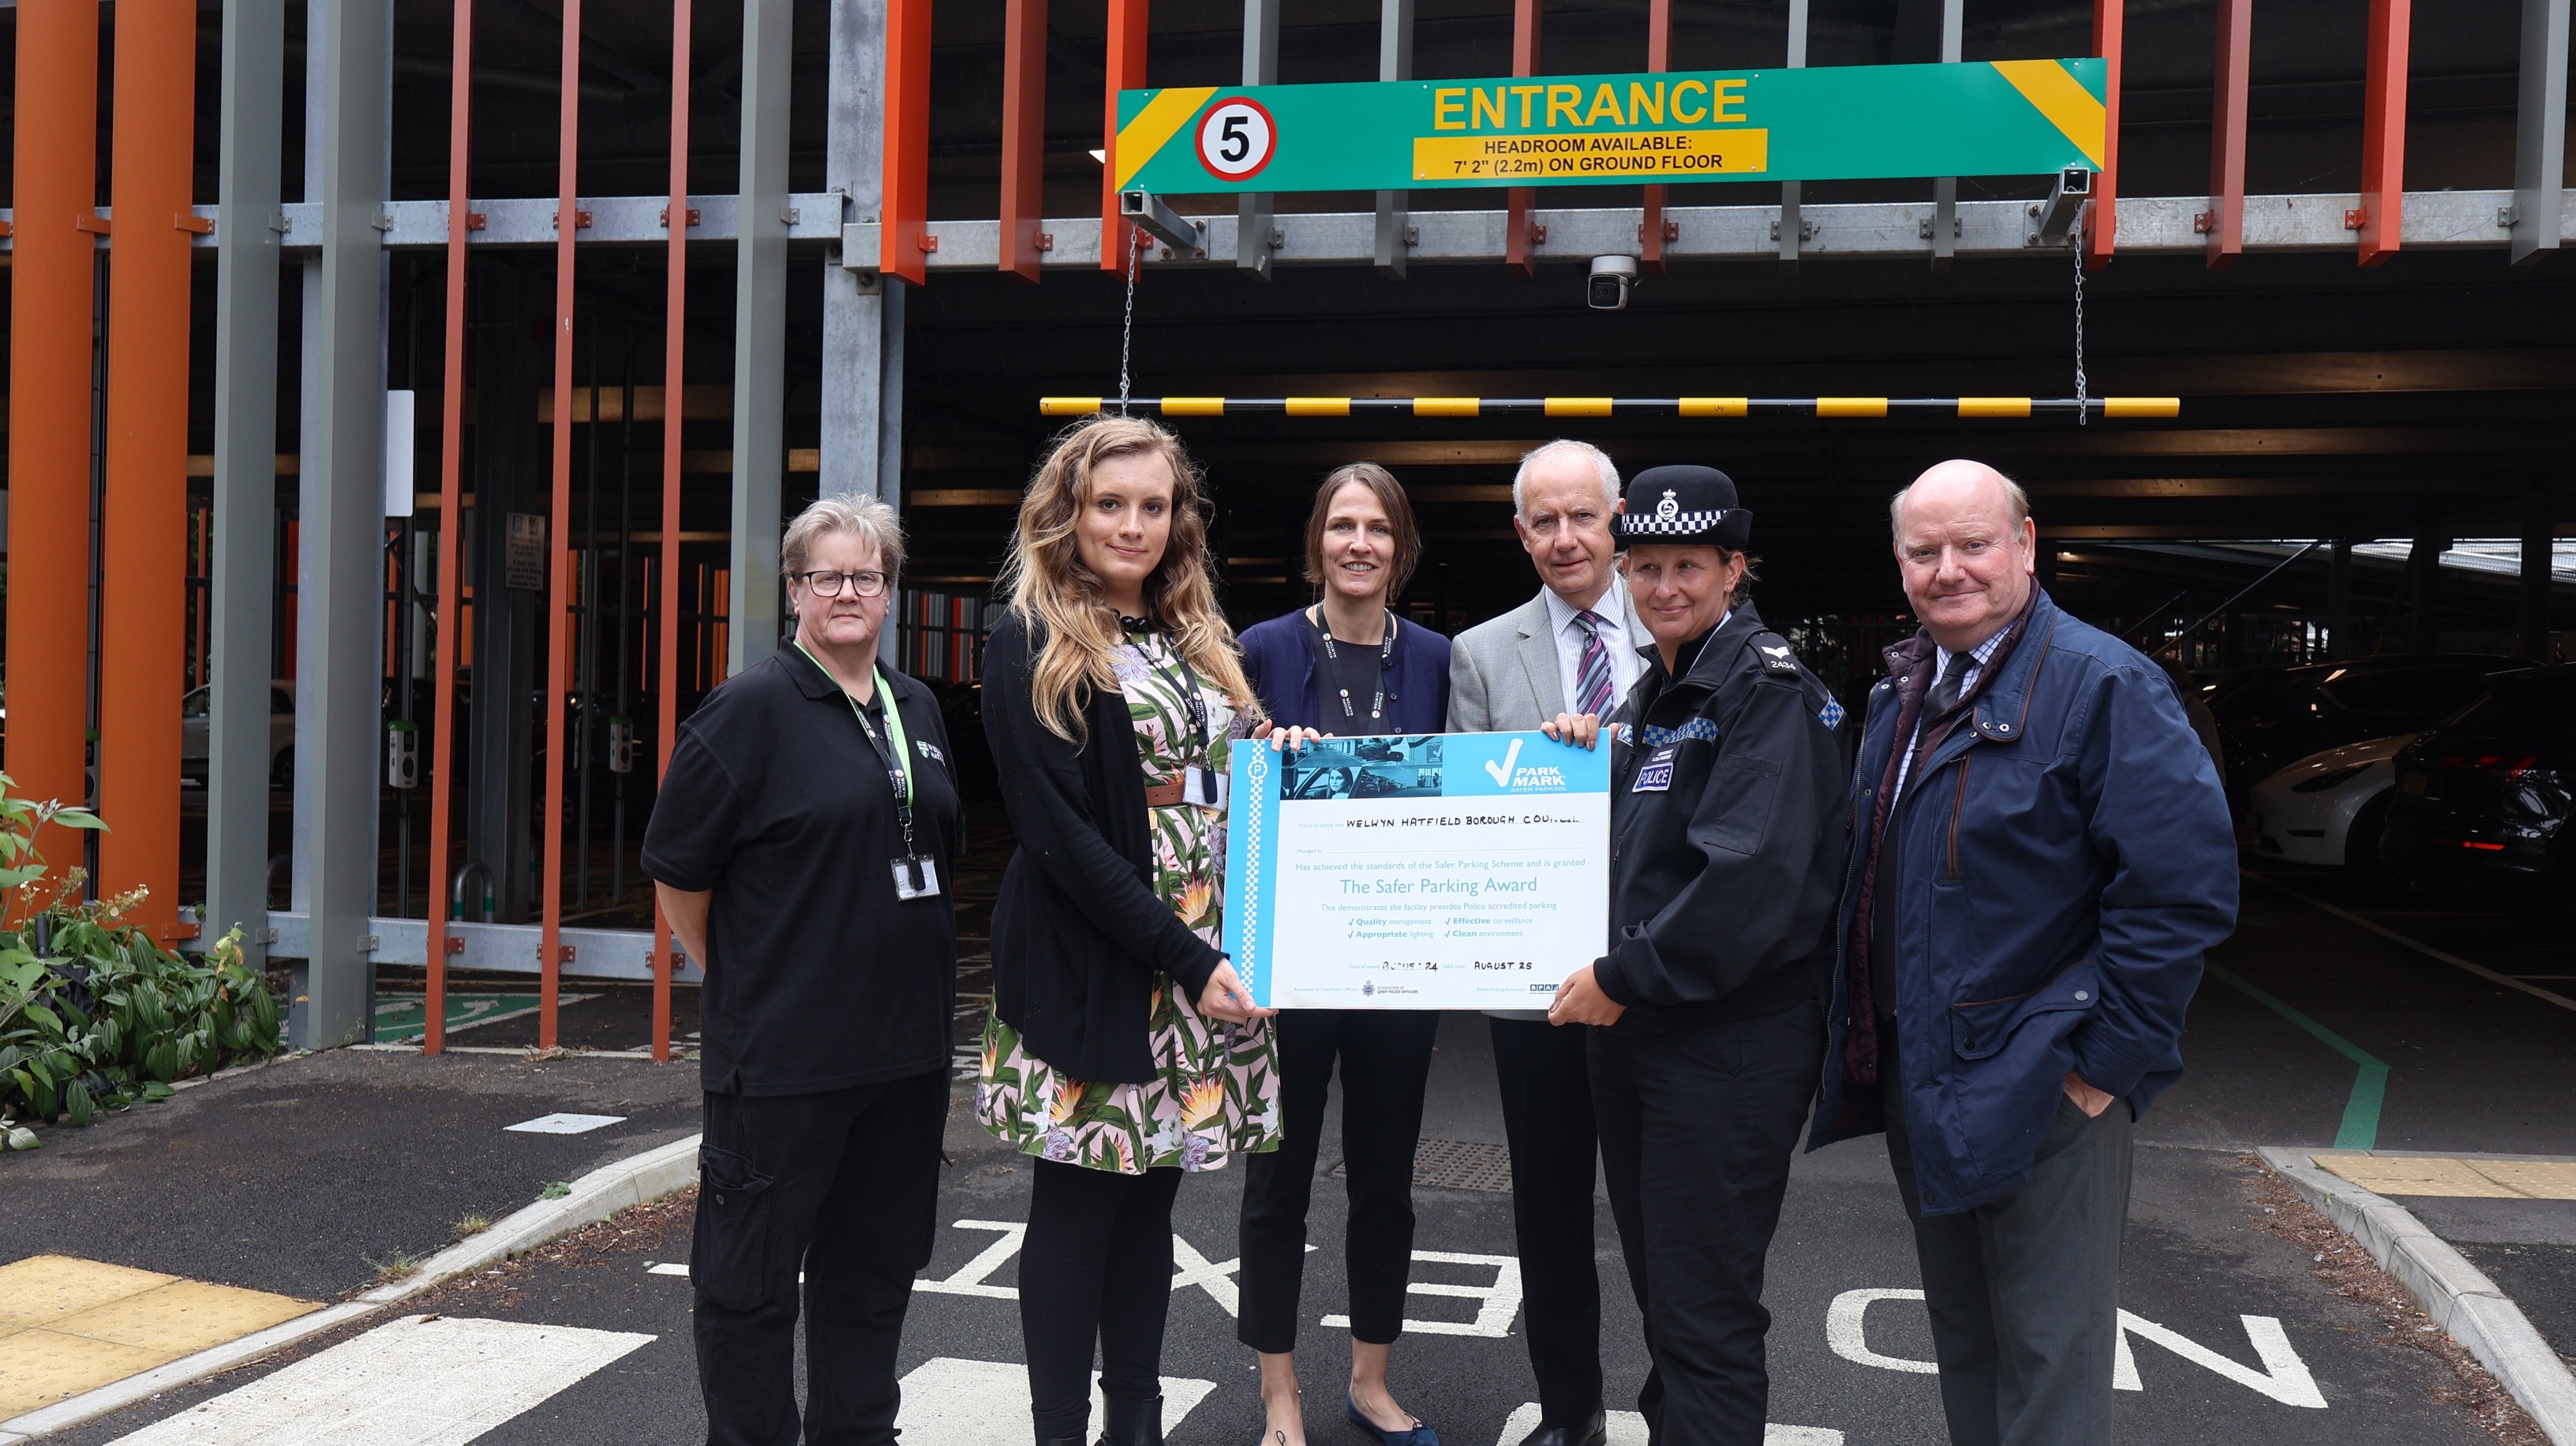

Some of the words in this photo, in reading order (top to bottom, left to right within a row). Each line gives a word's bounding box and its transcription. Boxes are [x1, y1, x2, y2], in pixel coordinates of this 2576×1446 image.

[1434, 78, 1747, 130] ENTRANCE
[1220, 116, 1250, 163] 5
[1485, 138, 1586, 155] HEADROOM
[1589, 136, 1693, 152] AVAILABLE:
[1454, 160, 1467, 174] 7'
[1471, 159, 1489, 174] 2"
[1493, 159, 1544, 177] (2.2m)
[1548, 158, 1574, 171] ON
[1579, 156, 1656, 171] GROUND
[1661, 154, 1723, 169] FLOOR
[1770, 661, 1796, 670] 2434
[1342, 699, 1350, 717] HATFIELD
[1346, 697, 1354, 717] WELWYN
[1516, 766, 1561, 776] PARK
[1512, 776, 1566, 787] MARK
[1638, 769, 1669, 786] POLICE
[1346, 819, 1395, 828] WELWYN
[1402, 816, 1461, 826] HATFIELD
[1466, 815, 1515, 826] BOROUGH
[1435, 860, 1455, 869] Safer
[1458, 860, 1488, 870] Parking
[1526, 859, 1541, 867] and
[1553, 858, 1586, 868] granted
[1340, 878, 1370, 894] The
[1376, 878, 1414, 893] Safer
[1421, 878, 1479, 897] Parking
[1484, 877, 1537, 892] Award
[1404, 903, 1428, 912] facility
[1429, 903, 1461, 912] provides
[1529, 901, 1557, 911] parking
[1356, 918, 1387, 927] Quality
[1356, 931, 1408, 939] Appropriate
[1409, 931, 1434, 939] lighting
[1425, 961, 1439, 972] 24
[1474, 961, 1515, 970] AUGUST
[1519, 961, 1532, 970] 25
